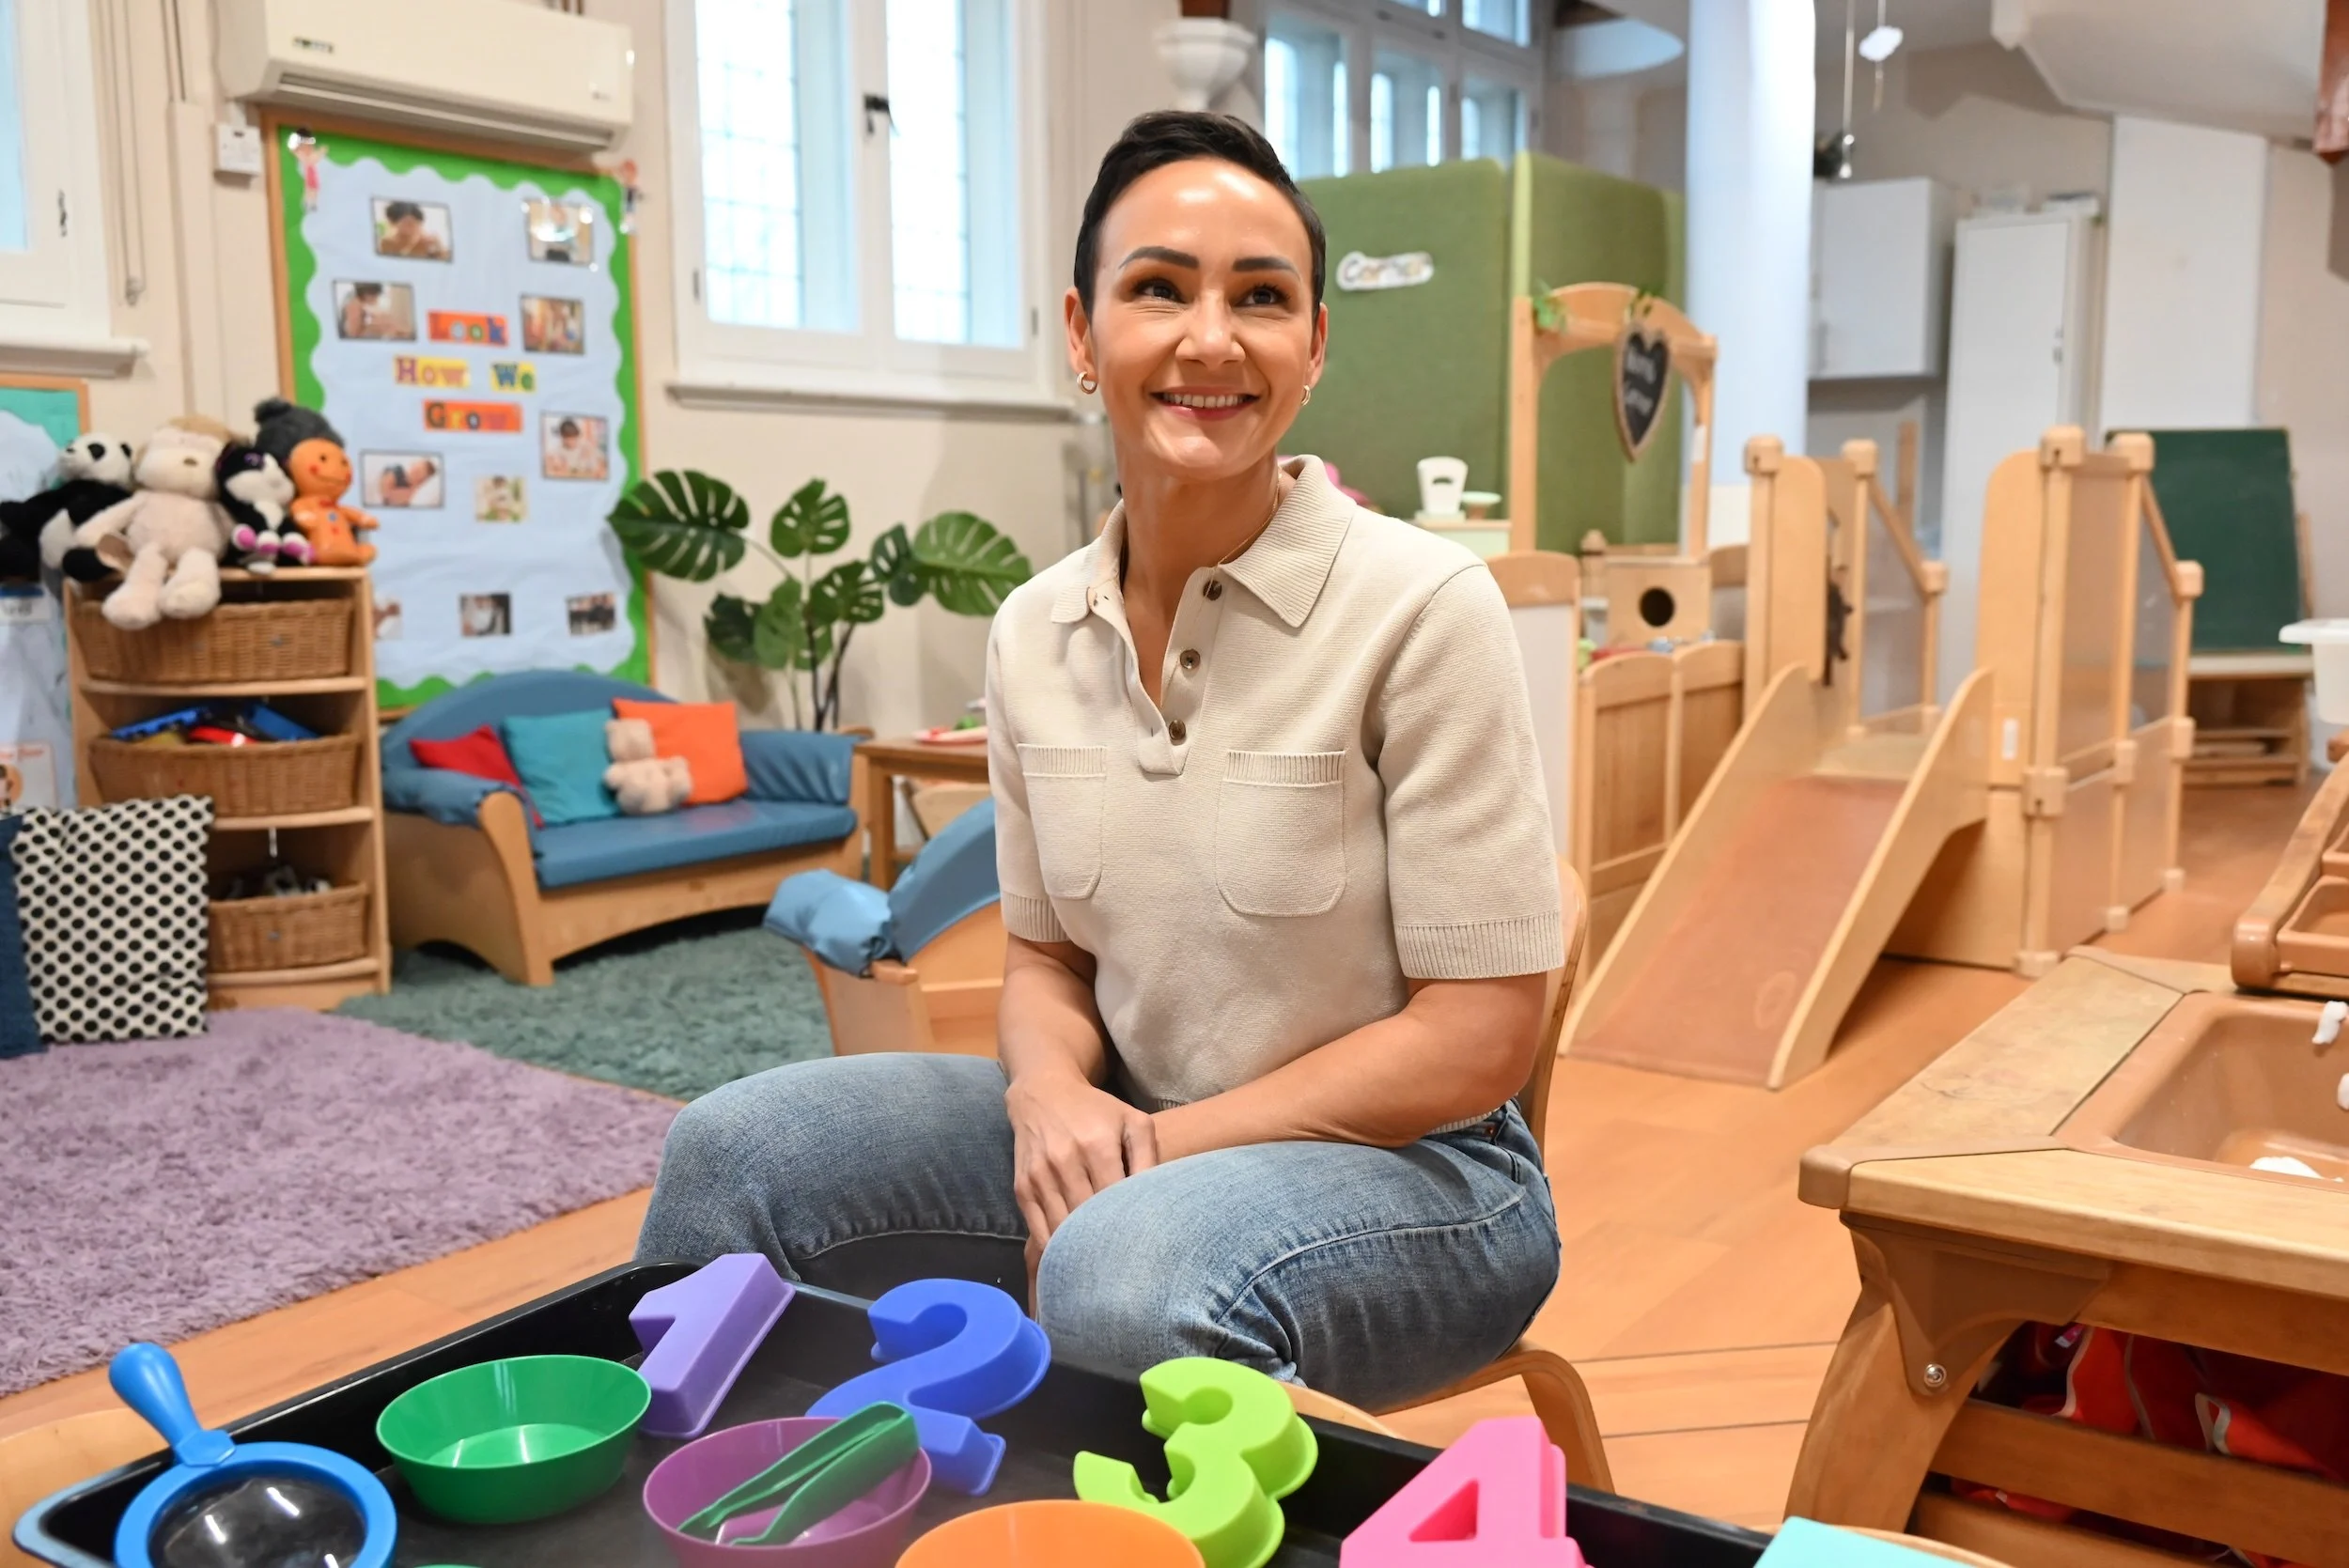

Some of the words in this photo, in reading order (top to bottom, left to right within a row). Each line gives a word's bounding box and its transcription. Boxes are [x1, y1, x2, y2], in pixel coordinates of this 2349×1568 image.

[396, 357, 466, 385] How
[491, 363, 535, 391] We
[428, 312, 507, 346] Look
[629, 1253, 796, 1439] 1
[805, 1278, 1051, 1496] 2
[1073, 1356, 1319, 1568] 3
[1339, 1415, 1584, 1568] 4
